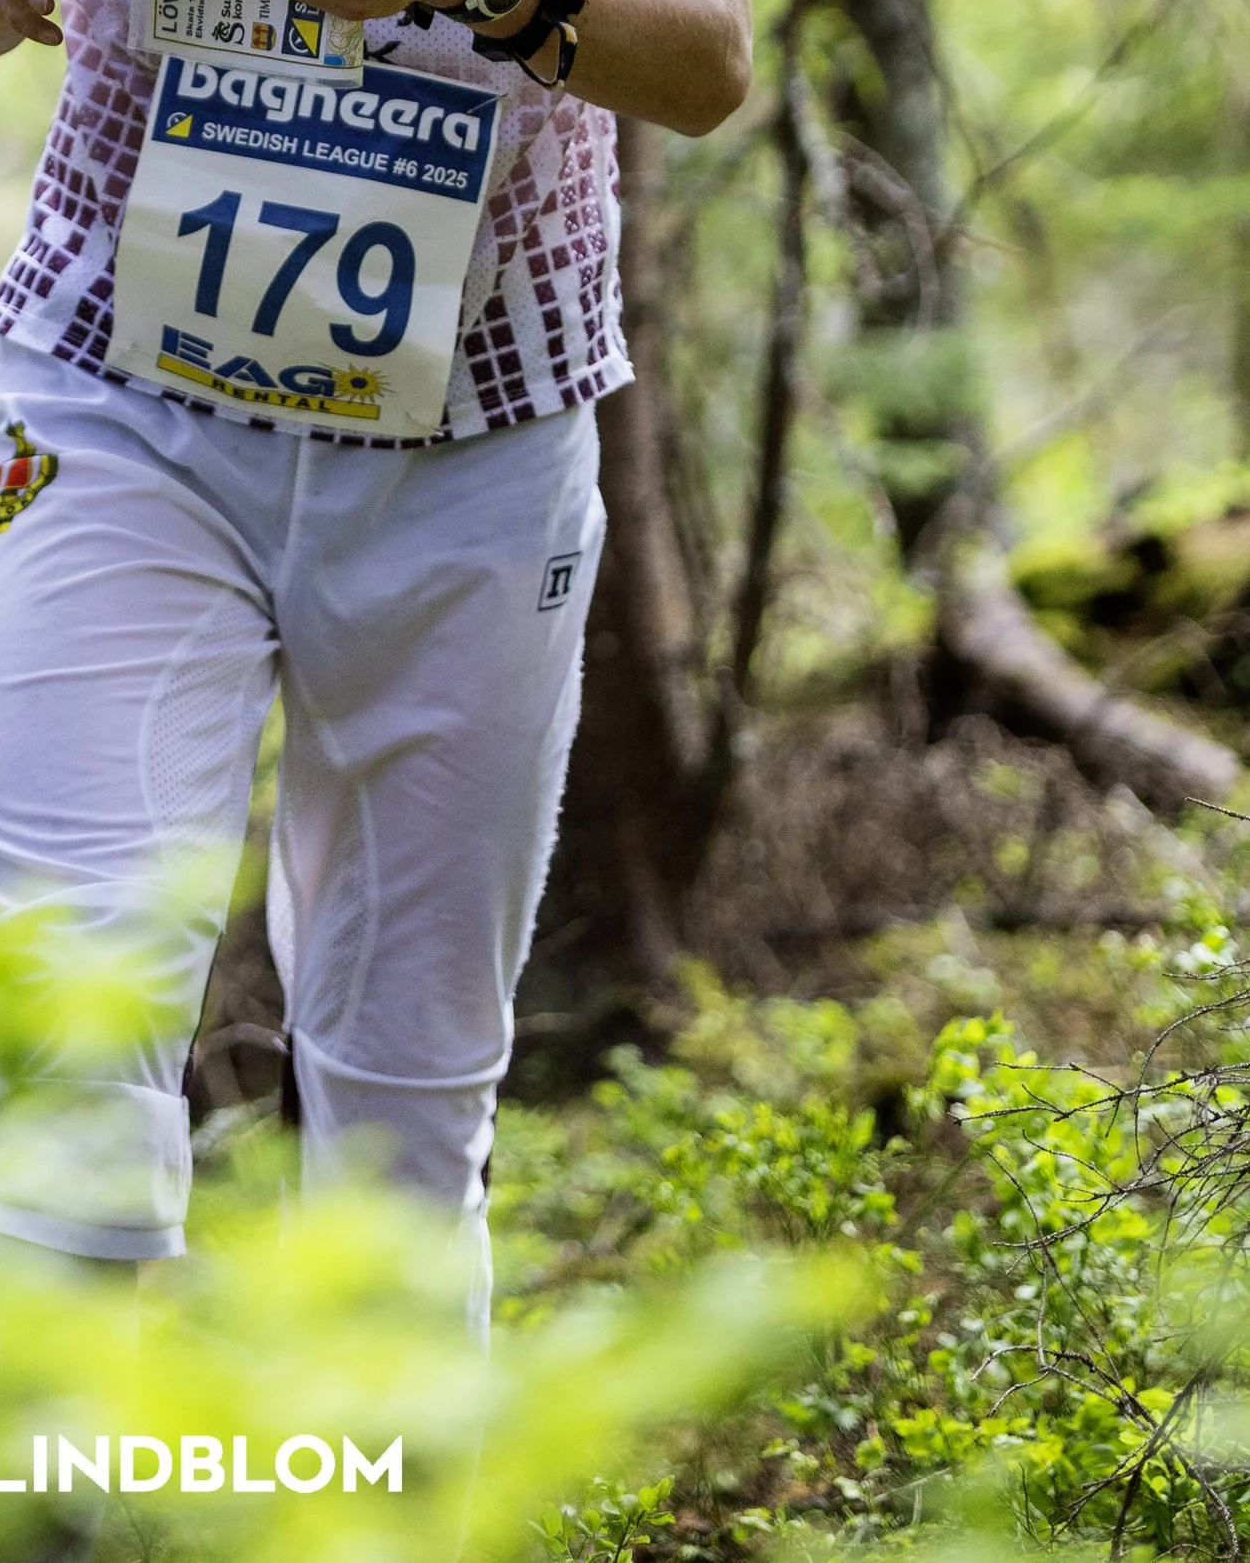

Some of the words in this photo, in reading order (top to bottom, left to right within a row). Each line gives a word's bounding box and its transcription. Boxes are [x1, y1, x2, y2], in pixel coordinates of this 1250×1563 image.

[202, 121, 300, 154] SWEDISH
[302, 142, 390, 173] LEAGUE
[392, 157, 419, 179] #6
[421, 162, 469, 189] 2025
[177, 190, 416, 357] 179
[212, 378, 332, 412] RENTAL
